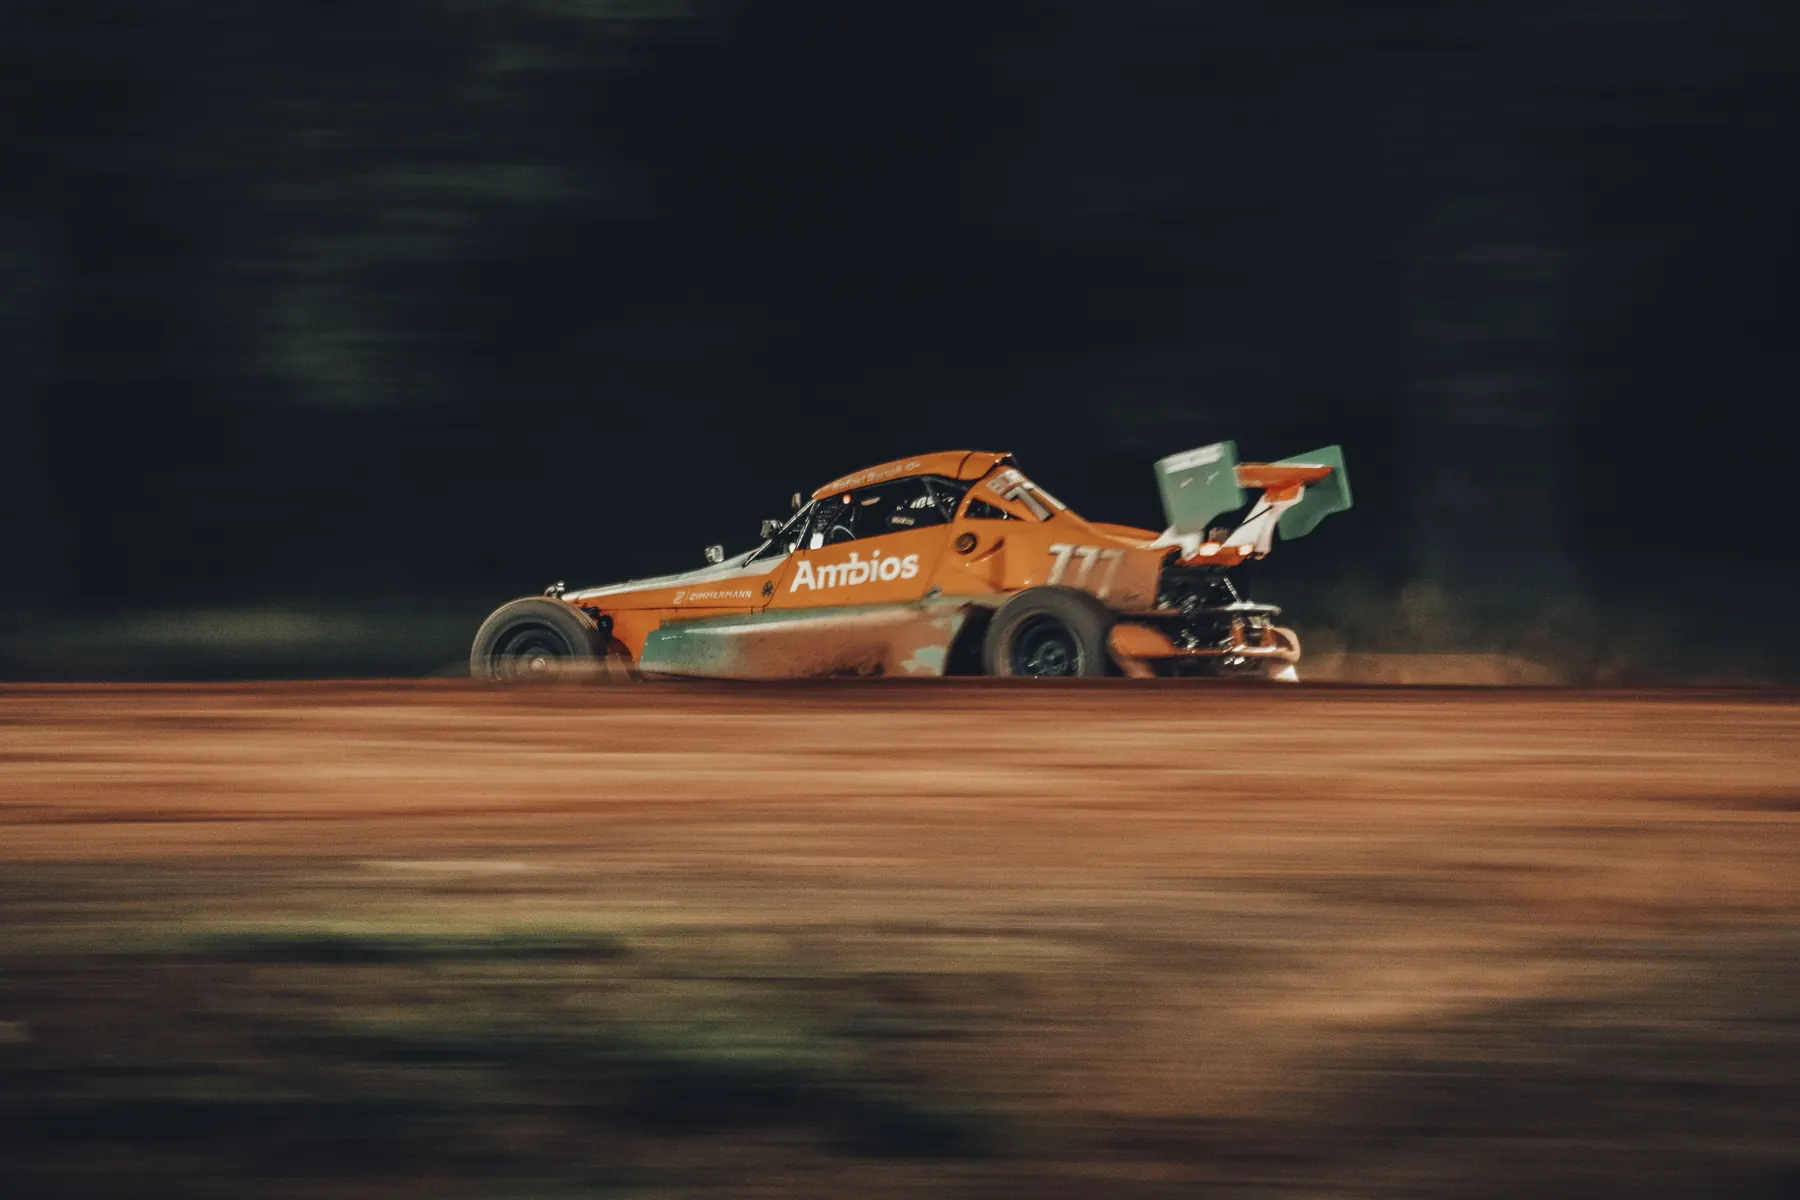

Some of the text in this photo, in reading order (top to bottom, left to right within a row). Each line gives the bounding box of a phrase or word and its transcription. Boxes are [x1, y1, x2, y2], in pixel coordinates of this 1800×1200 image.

[789, 548, 920, 593] Ambios
[1047, 543, 1126, 599] 777
[689, 590, 752, 601] ZIMMERMANN
